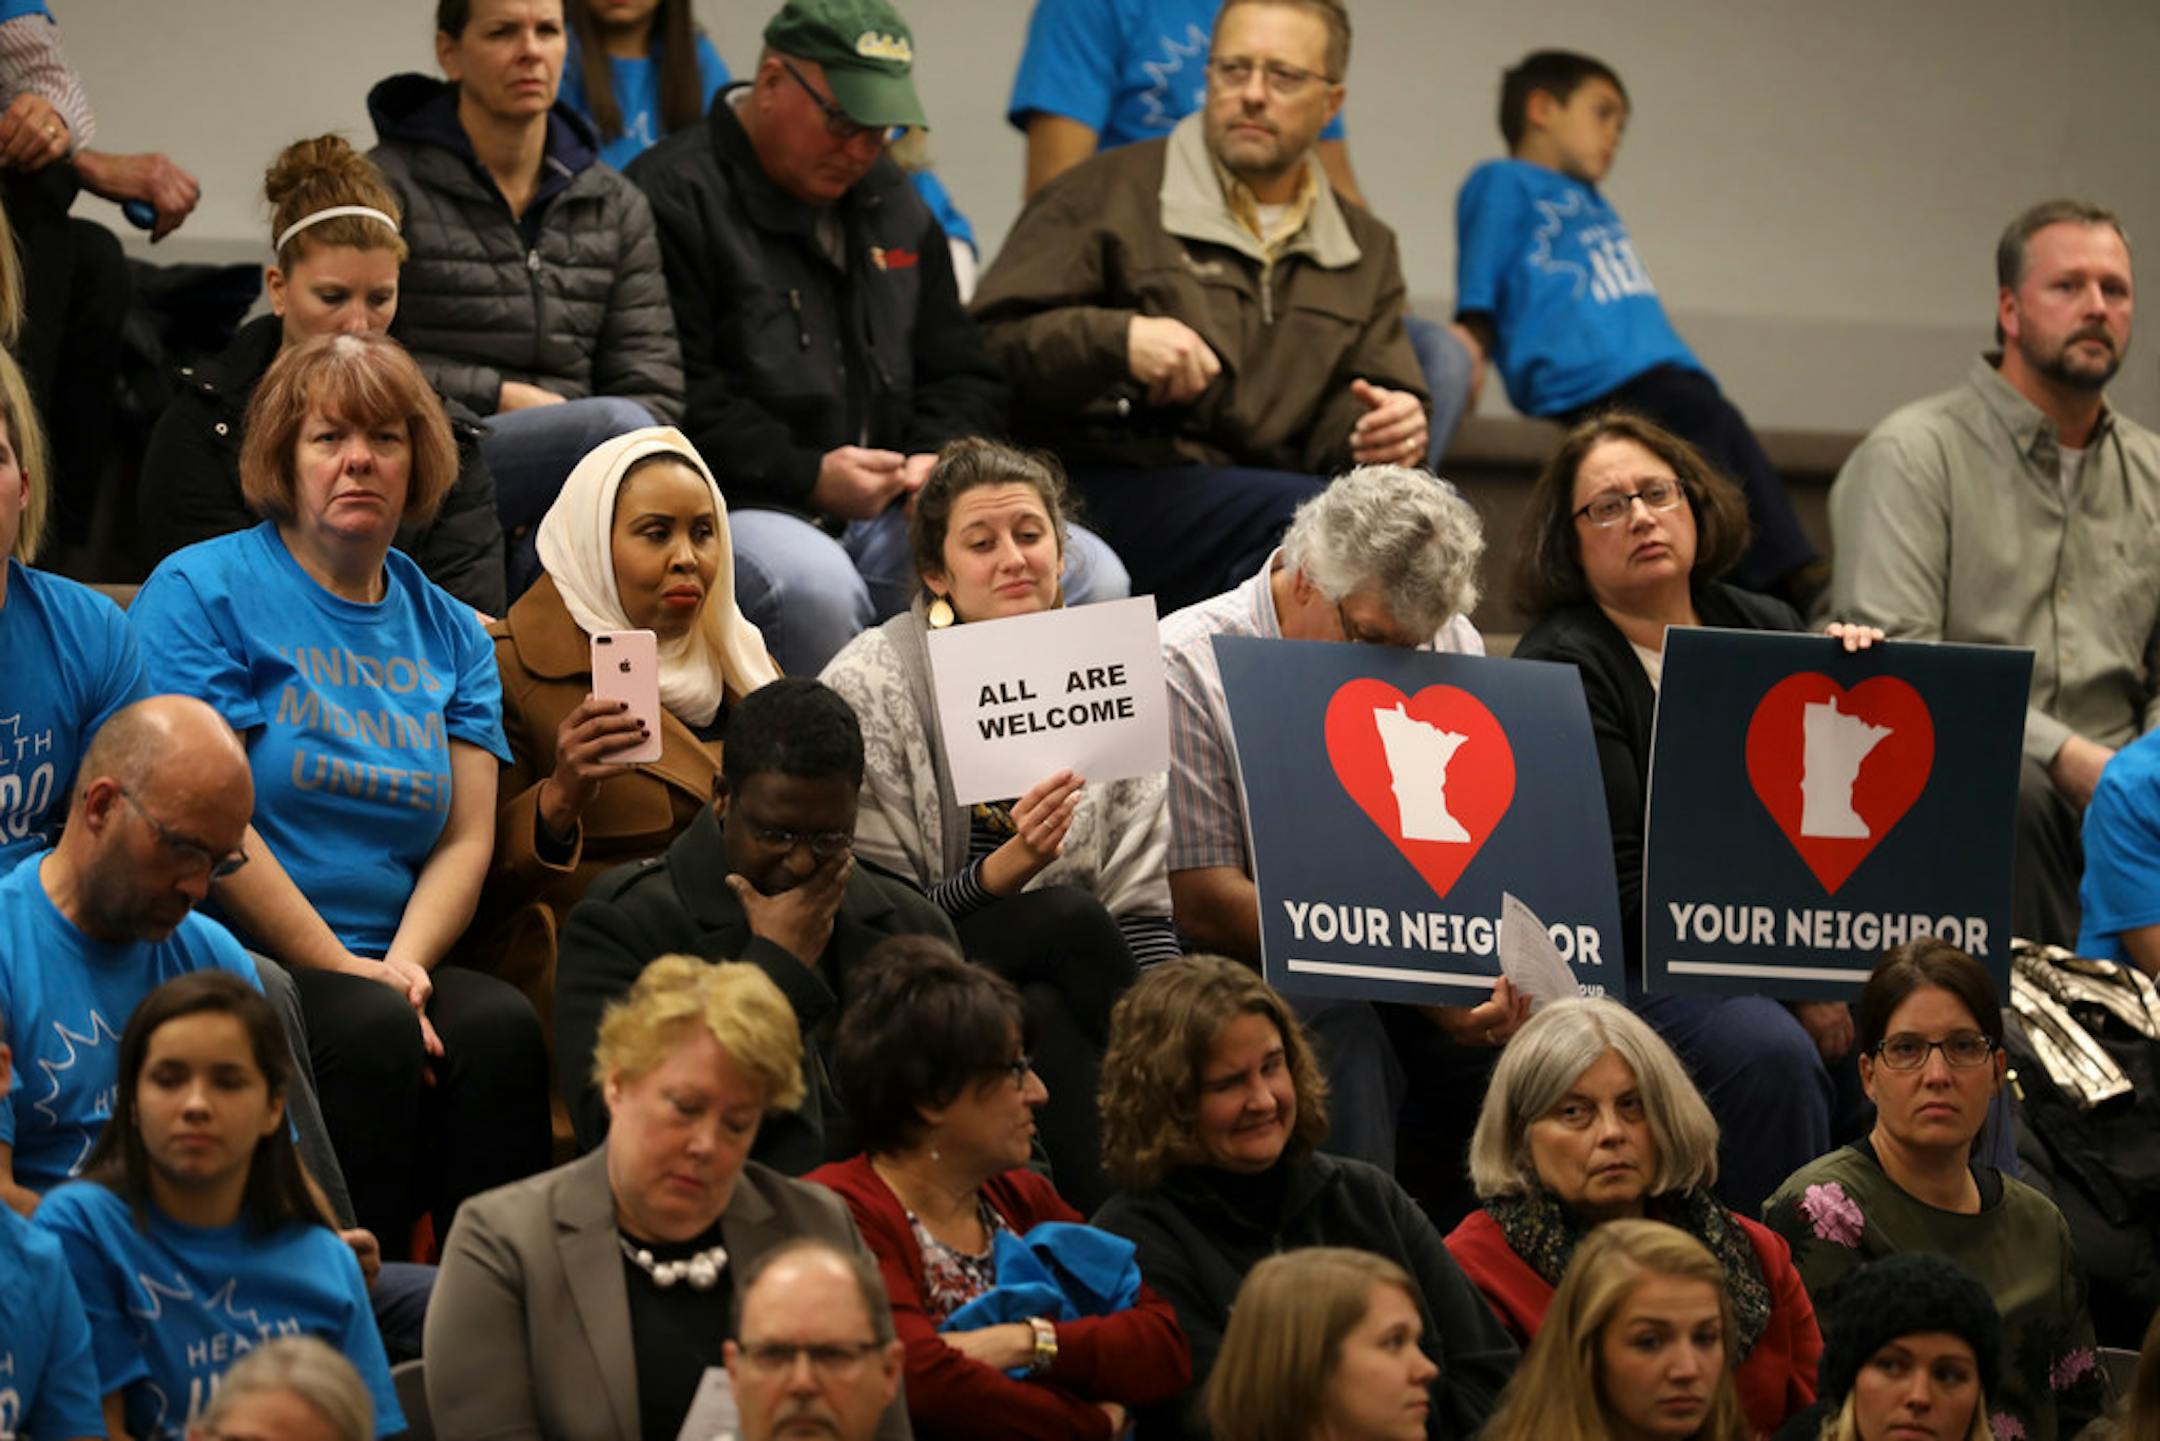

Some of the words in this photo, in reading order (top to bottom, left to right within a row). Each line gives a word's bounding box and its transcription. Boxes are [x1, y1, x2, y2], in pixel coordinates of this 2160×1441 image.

[978, 679, 1037, 707] ALL
[1066, 664, 1127, 693] ARE
[978, 696, 1135, 740] WELCOME
[1283, 900, 1392, 947] YOUR
[1400, 910, 1603, 965] NEIGOR
[1668, 902, 1776, 946] YOUR
[1786, 908, 1989, 956] NEIGHBOR
